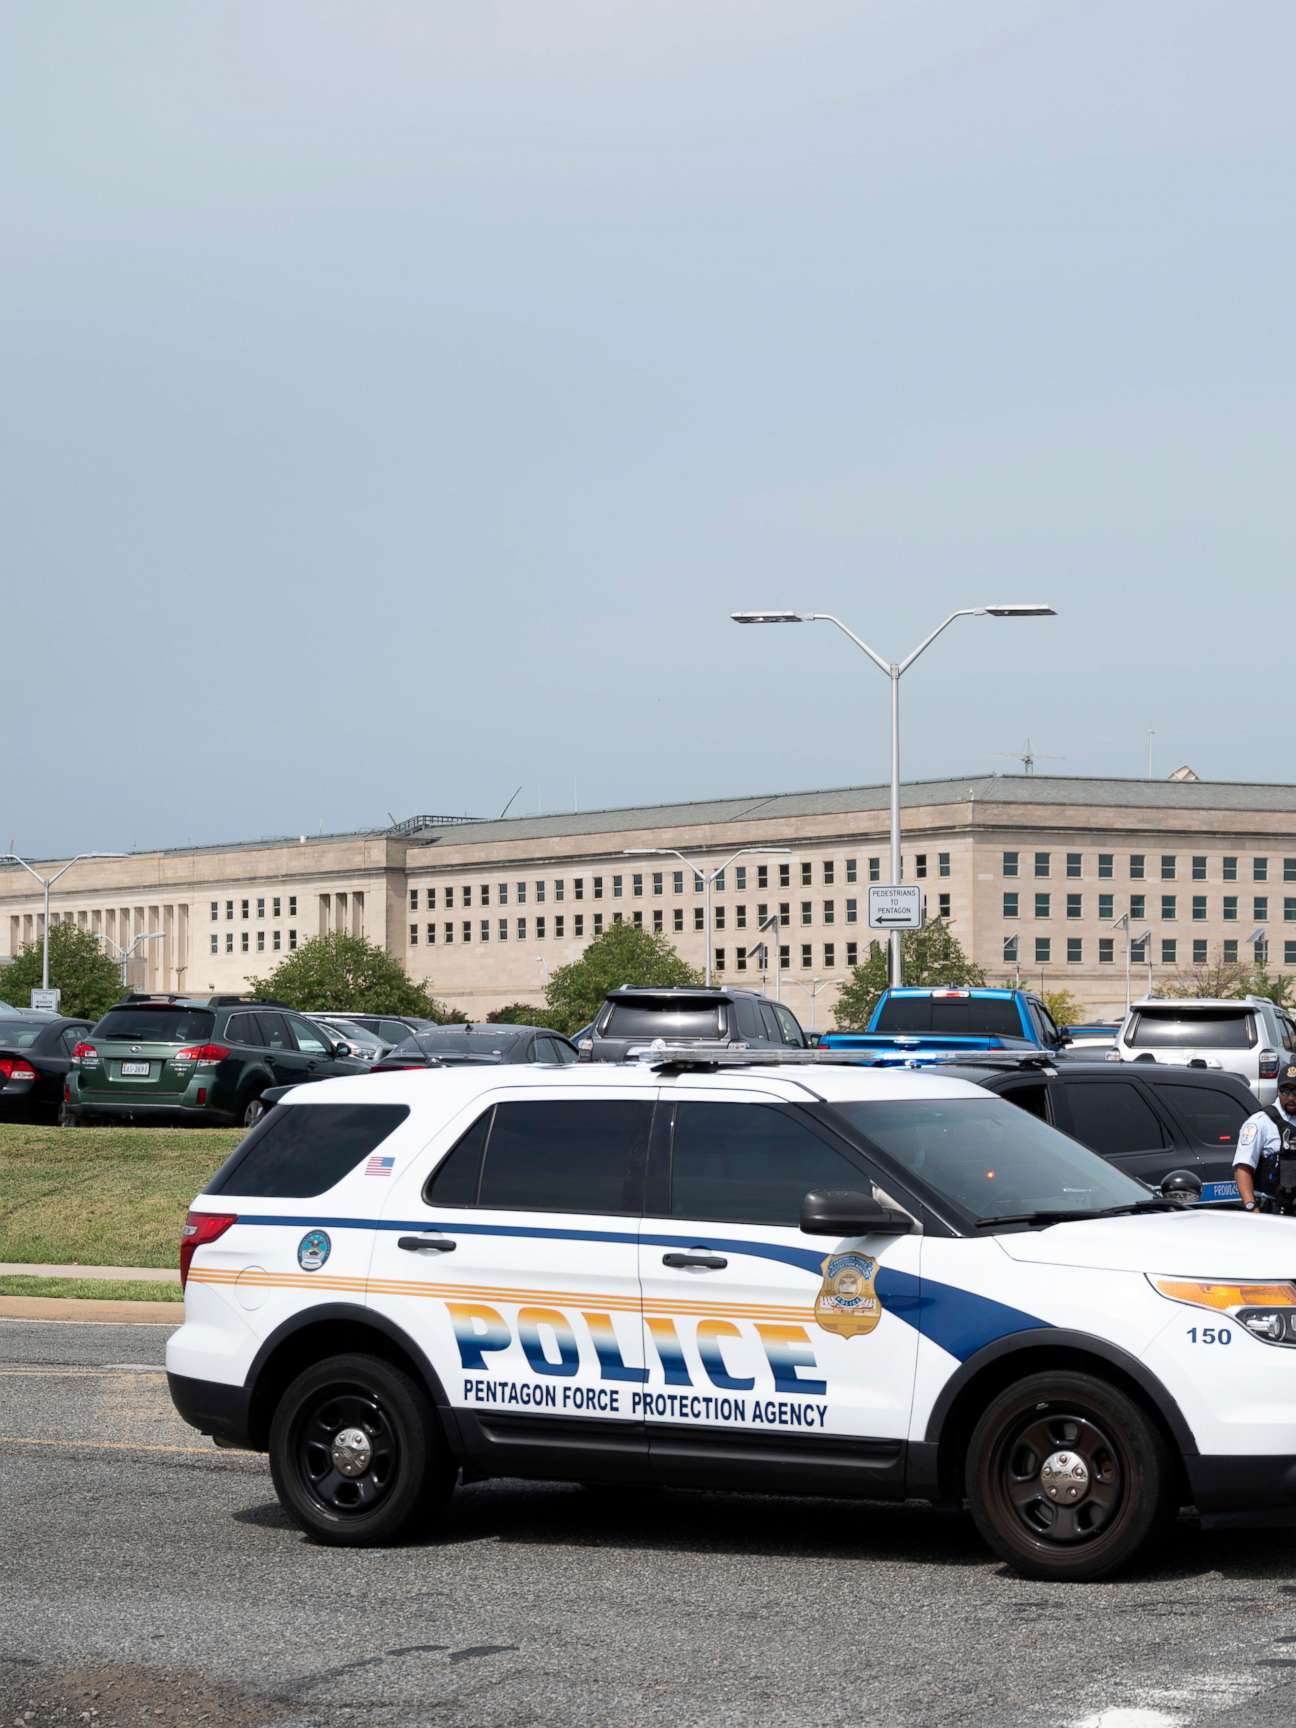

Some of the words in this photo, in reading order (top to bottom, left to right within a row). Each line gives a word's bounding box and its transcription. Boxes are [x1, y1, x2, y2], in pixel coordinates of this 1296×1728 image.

[445, 1302, 827, 1395] POLICE
[1186, 1327, 1232, 1345] 150
[464, 1379, 555, 1408] PENTAGON
[562, 1386, 619, 1412] FORCE
[632, 1391, 746, 1421] PROTECTION
[752, 1402, 828, 1428] AGENCY
